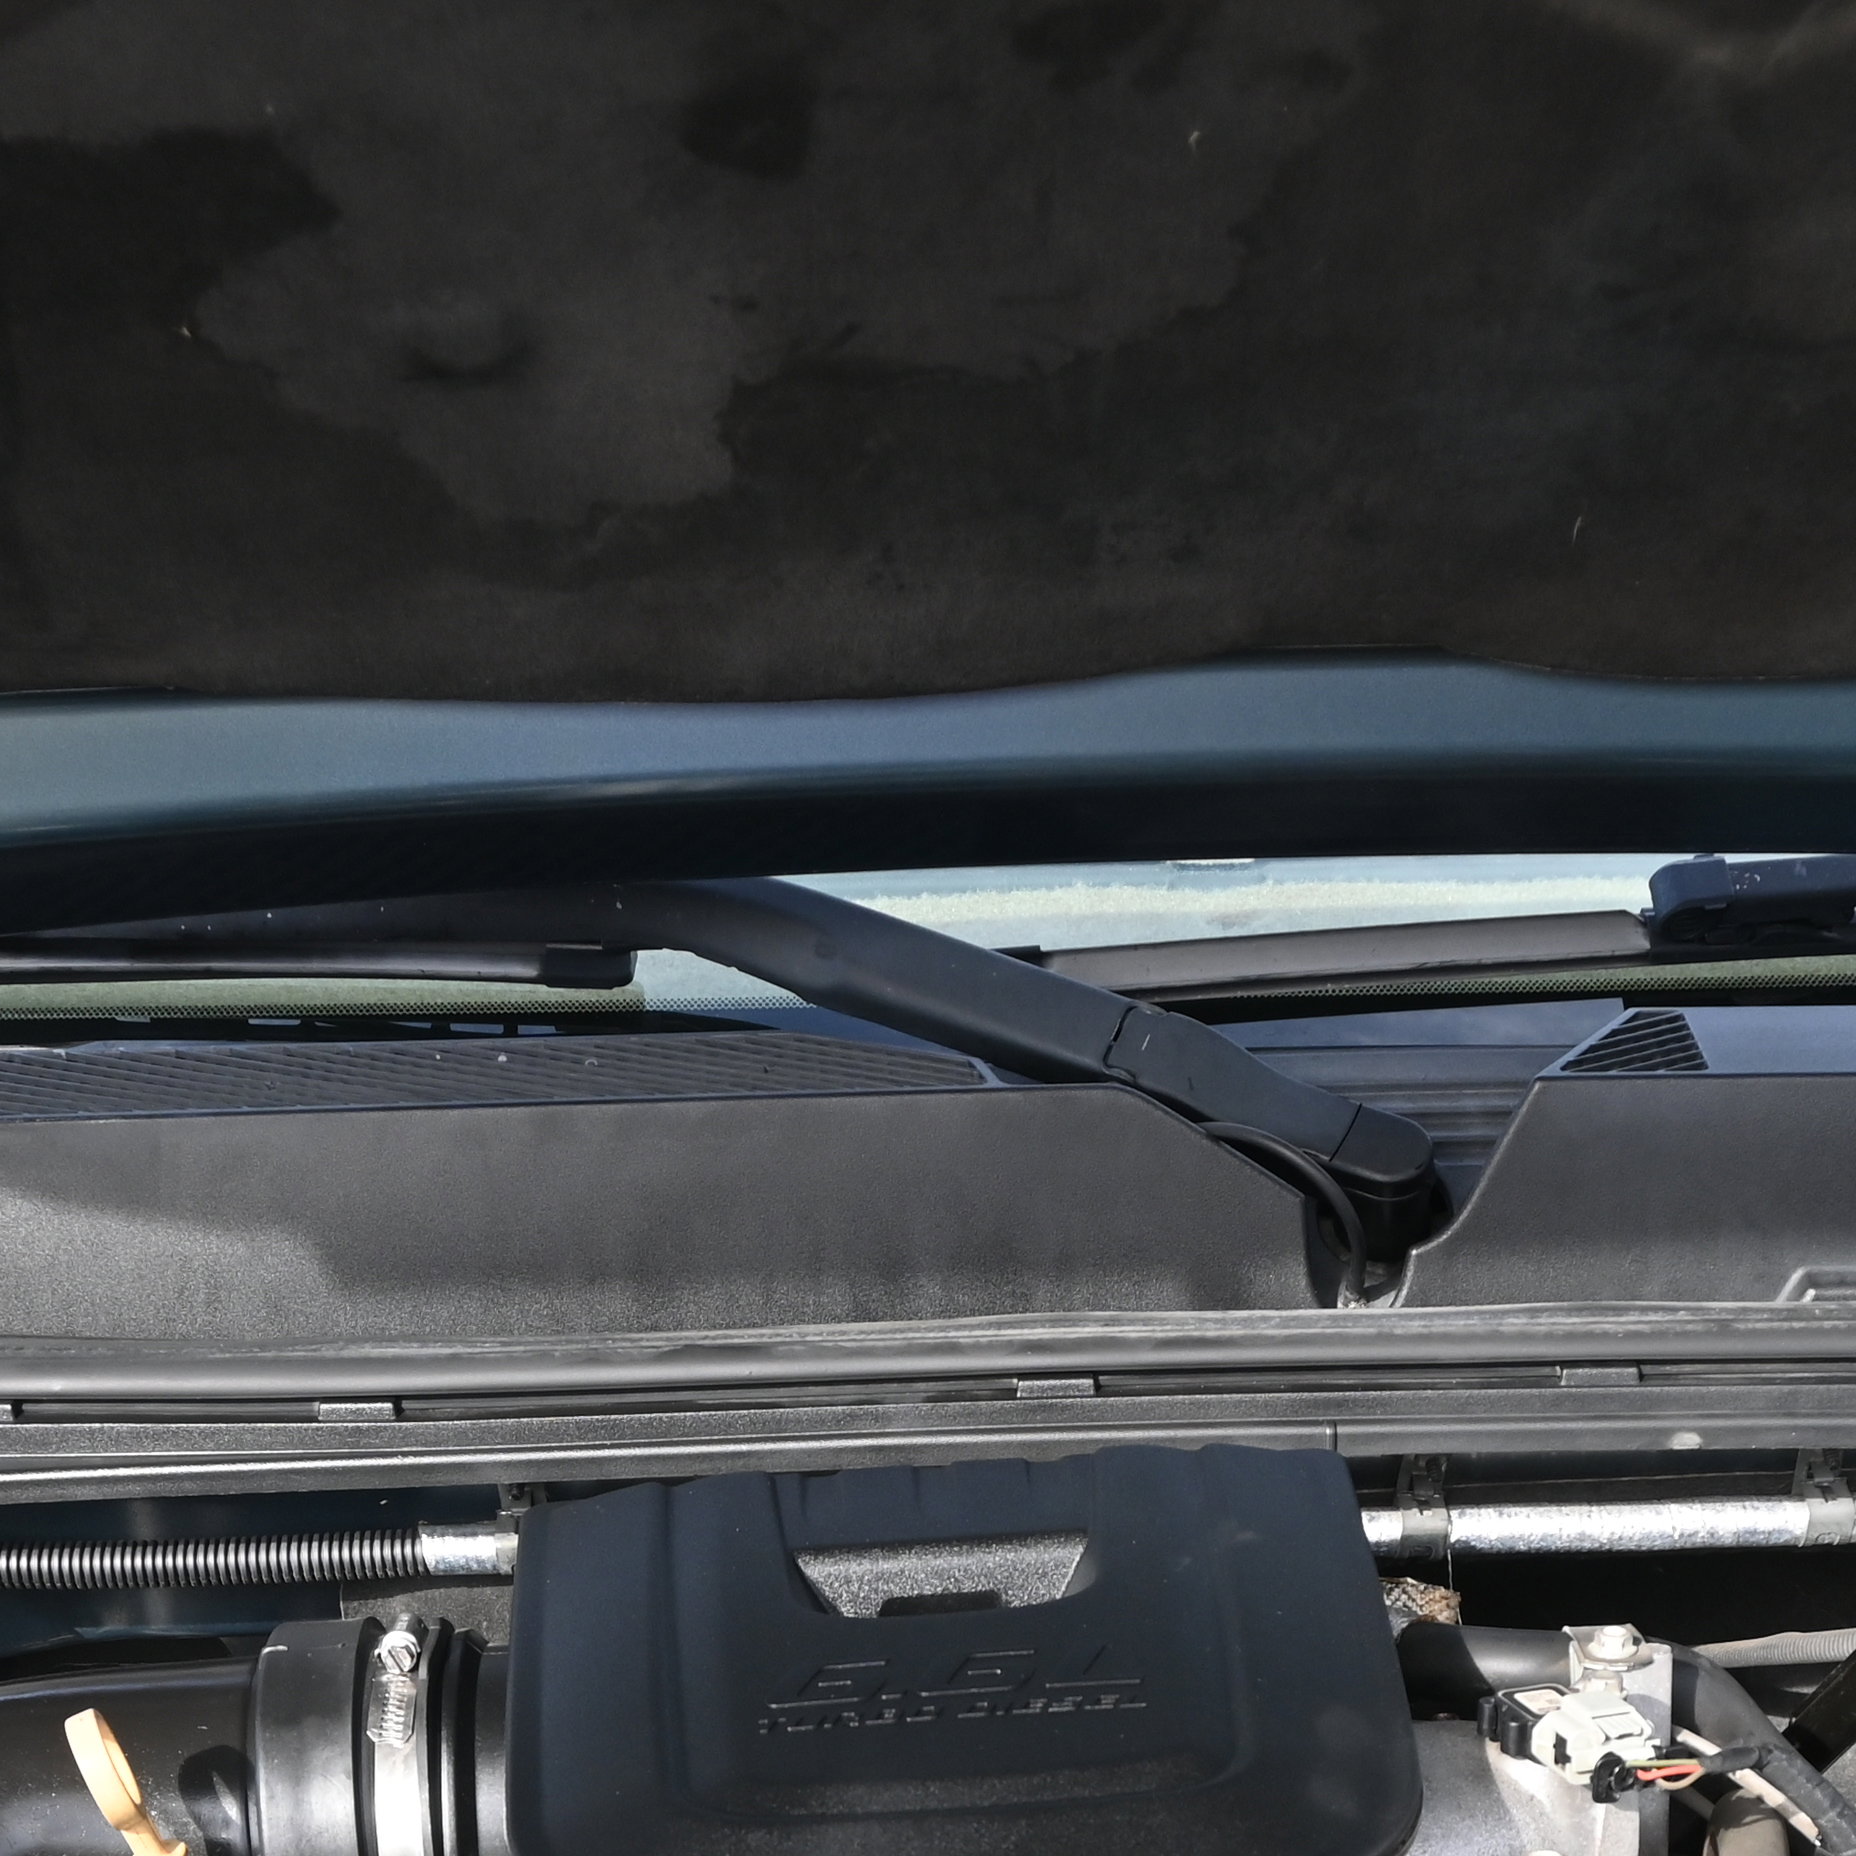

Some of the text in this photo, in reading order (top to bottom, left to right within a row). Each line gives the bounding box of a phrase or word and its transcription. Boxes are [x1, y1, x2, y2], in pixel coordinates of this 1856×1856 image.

[766, 1643, 1141, 1709] 6.6L
[758, 1693, 1147, 1735] TURBO DIESEL
